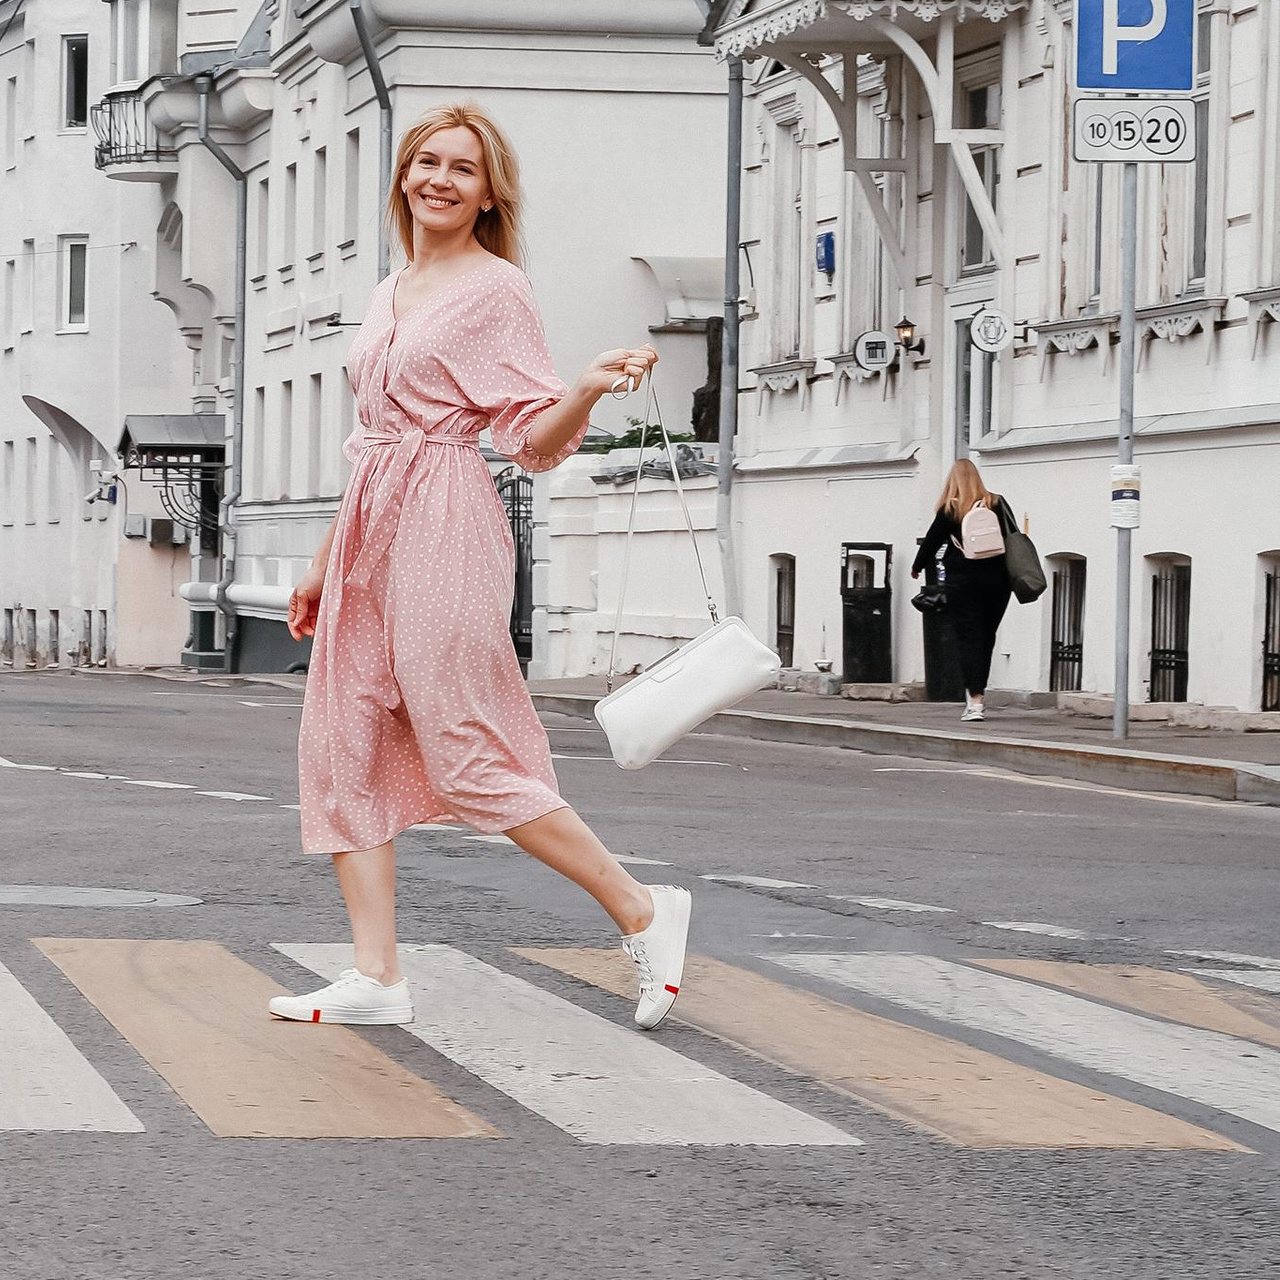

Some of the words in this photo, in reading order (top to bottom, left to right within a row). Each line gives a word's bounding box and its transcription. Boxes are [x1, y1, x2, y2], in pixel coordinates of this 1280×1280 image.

[1089, 122, 1107, 139] 10
[1114, 120, 1136, 141] 15
[1145, 118, 1181, 143] 20
